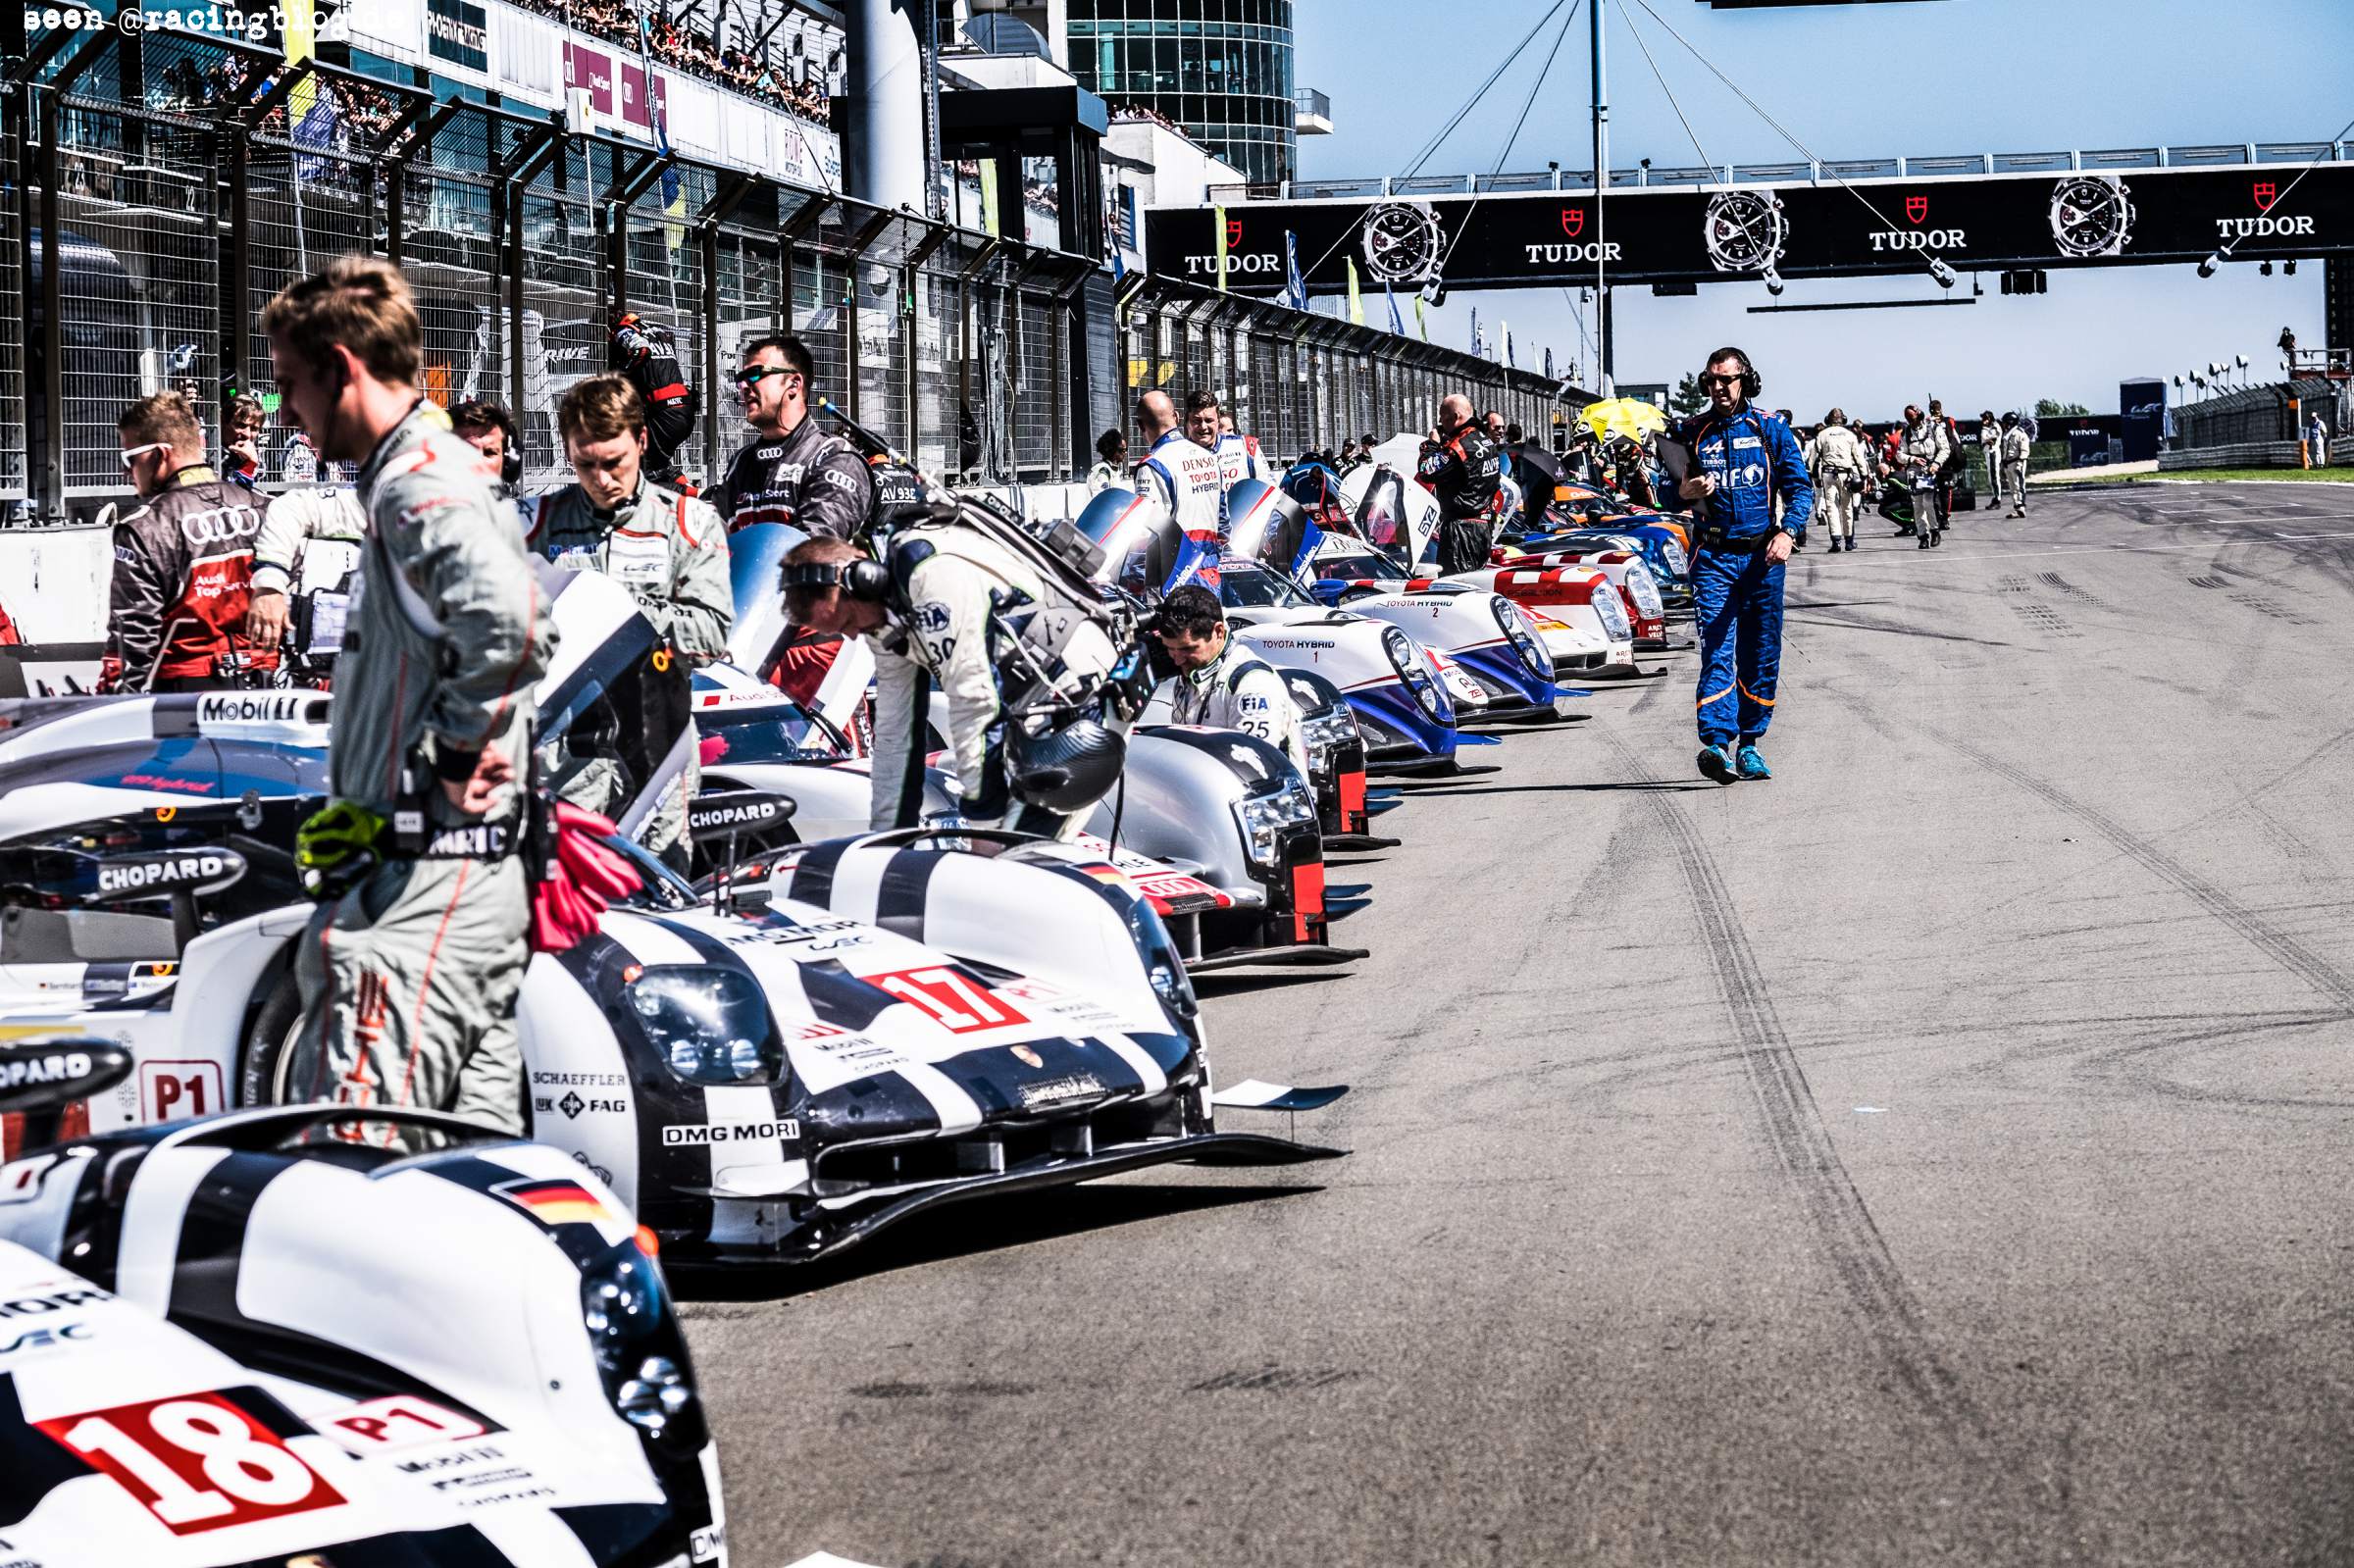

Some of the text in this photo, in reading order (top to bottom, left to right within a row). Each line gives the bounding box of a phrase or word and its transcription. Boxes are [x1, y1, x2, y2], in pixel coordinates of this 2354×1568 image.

[2217, 216, 2315, 237] TUDOR
[1869, 229, 1967, 251] TUDOR
[1525, 243, 1622, 263] TUDOR
[1185, 254, 1280, 274] TUDOR
[1182, 457, 1215, 472] DENSO
[1189, 471, 1217, 483] TOYOTA
[1420, 506, 1436, 535] SYZ
[196, 573, 227, 586] Audi
[196, 585, 222, 598] Top
[1432, 607, 1439, 618] 2
[929, 637, 956, 665] 30
[1313, 650, 1319, 664] 1
[203, 697, 270, 722] Mobil
[1242, 721, 1269, 739] 25
[691, 802, 776, 828] CHOPARD
[99, 857, 223, 890] CHOPARD
[882, 967, 1006, 1030] 17
[533, 1072, 626, 1087] SCHAEFFLER
[155, 1075, 205, 1120] P1
[589, 1100, 626, 1112] FAG
[667, 1124, 796, 1143] DMG MORI
[334, 1408, 445, 1442] P1
[66, 1399, 314, 1526] 18
